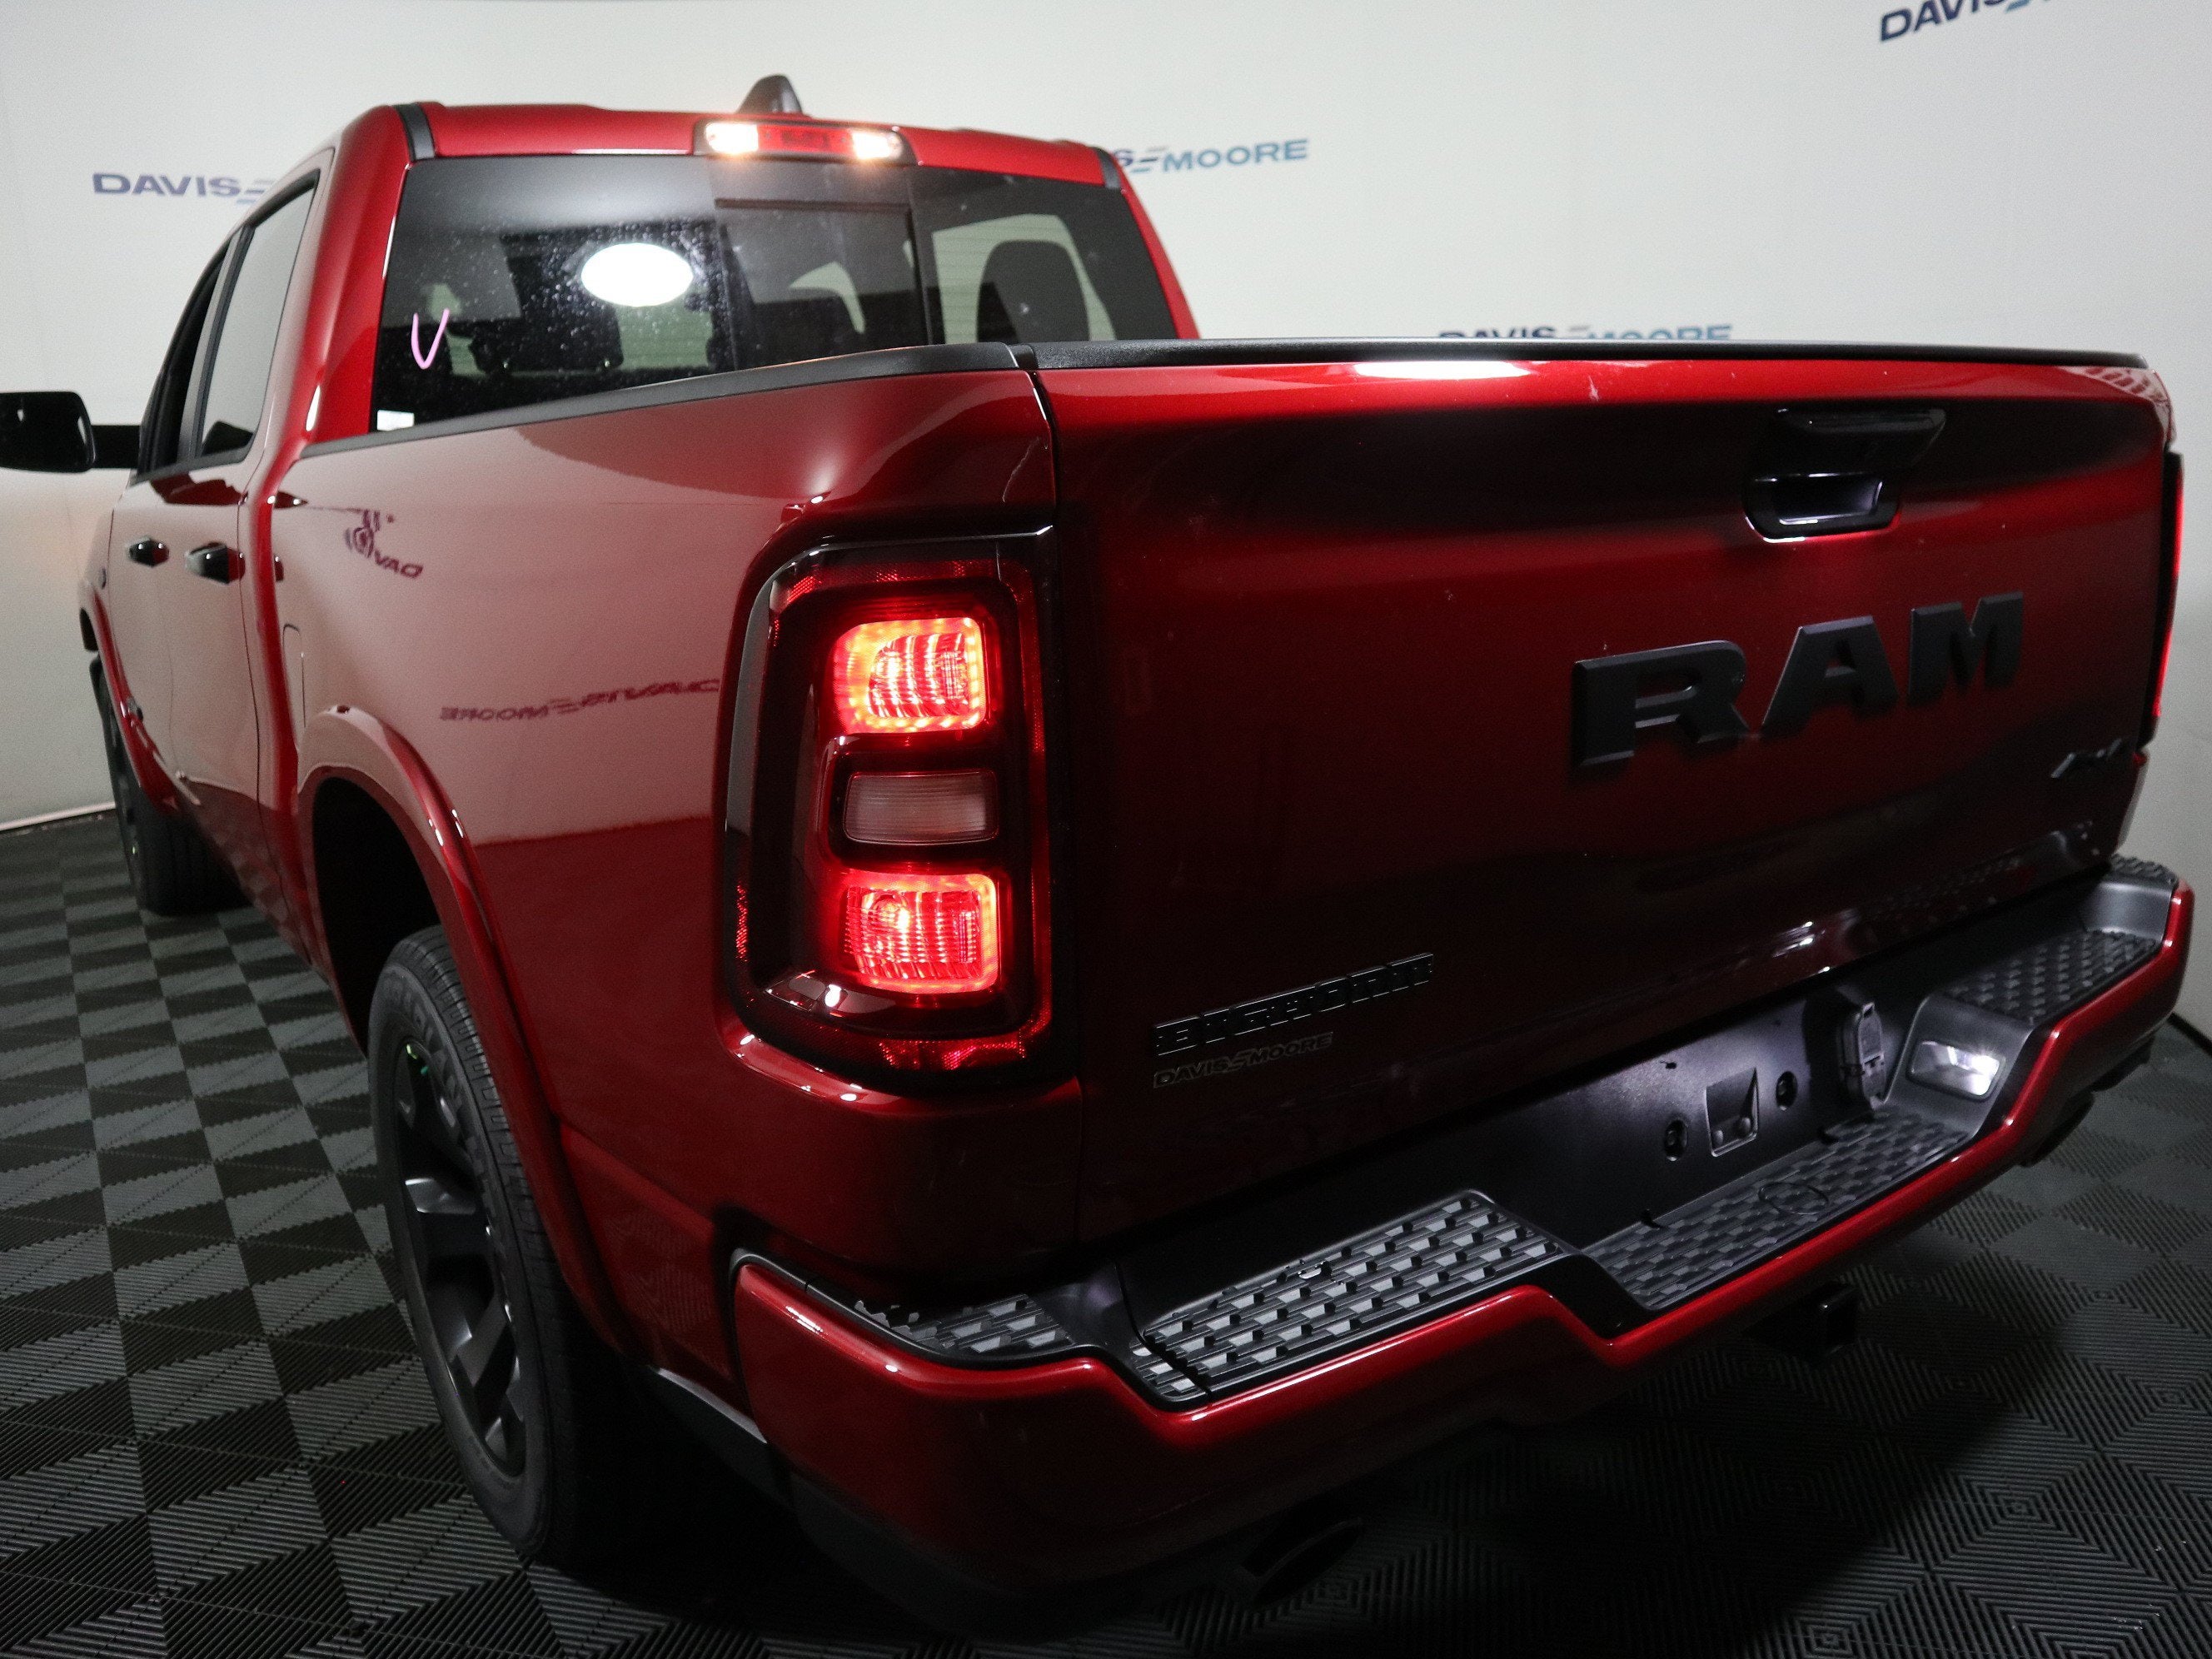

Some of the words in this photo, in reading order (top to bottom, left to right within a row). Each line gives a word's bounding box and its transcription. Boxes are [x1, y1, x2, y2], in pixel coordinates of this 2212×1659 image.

[1881, 0, 2000, 42] DAV
[1163, 138, 1308, 172] MOORE
[92, 173, 241, 197] DAVIS
[1572, 591, 2024, 767] RAM
